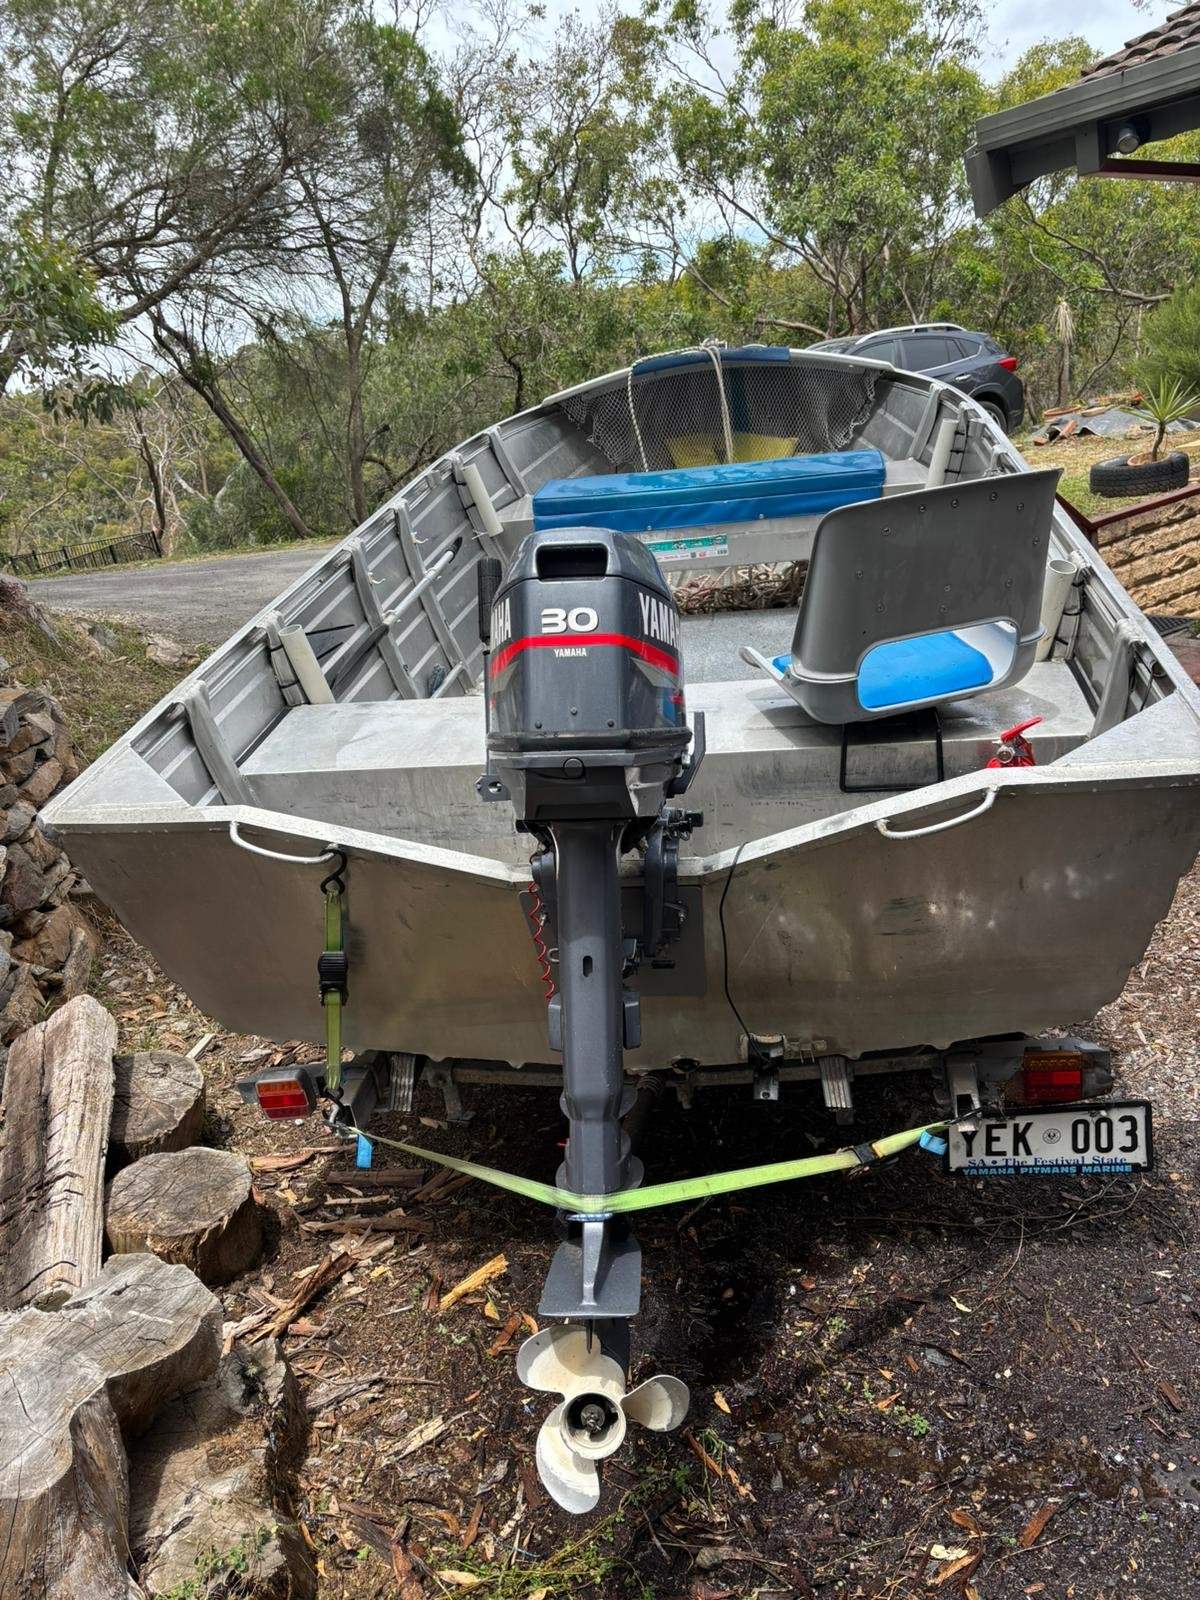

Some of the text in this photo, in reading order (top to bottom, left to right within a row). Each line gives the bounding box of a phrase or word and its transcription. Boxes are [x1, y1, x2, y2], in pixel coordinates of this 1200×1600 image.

[541, 607, 599, 633] 30
[554, 648, 587, 658] YAMAHA
[961, 1115, 1139, 1157] YEK 003
[967, 1155, 1127, 1167] SA The Festival State
[962, 1164, 1132, 1176] YAMAHA PITMANS MARINE
